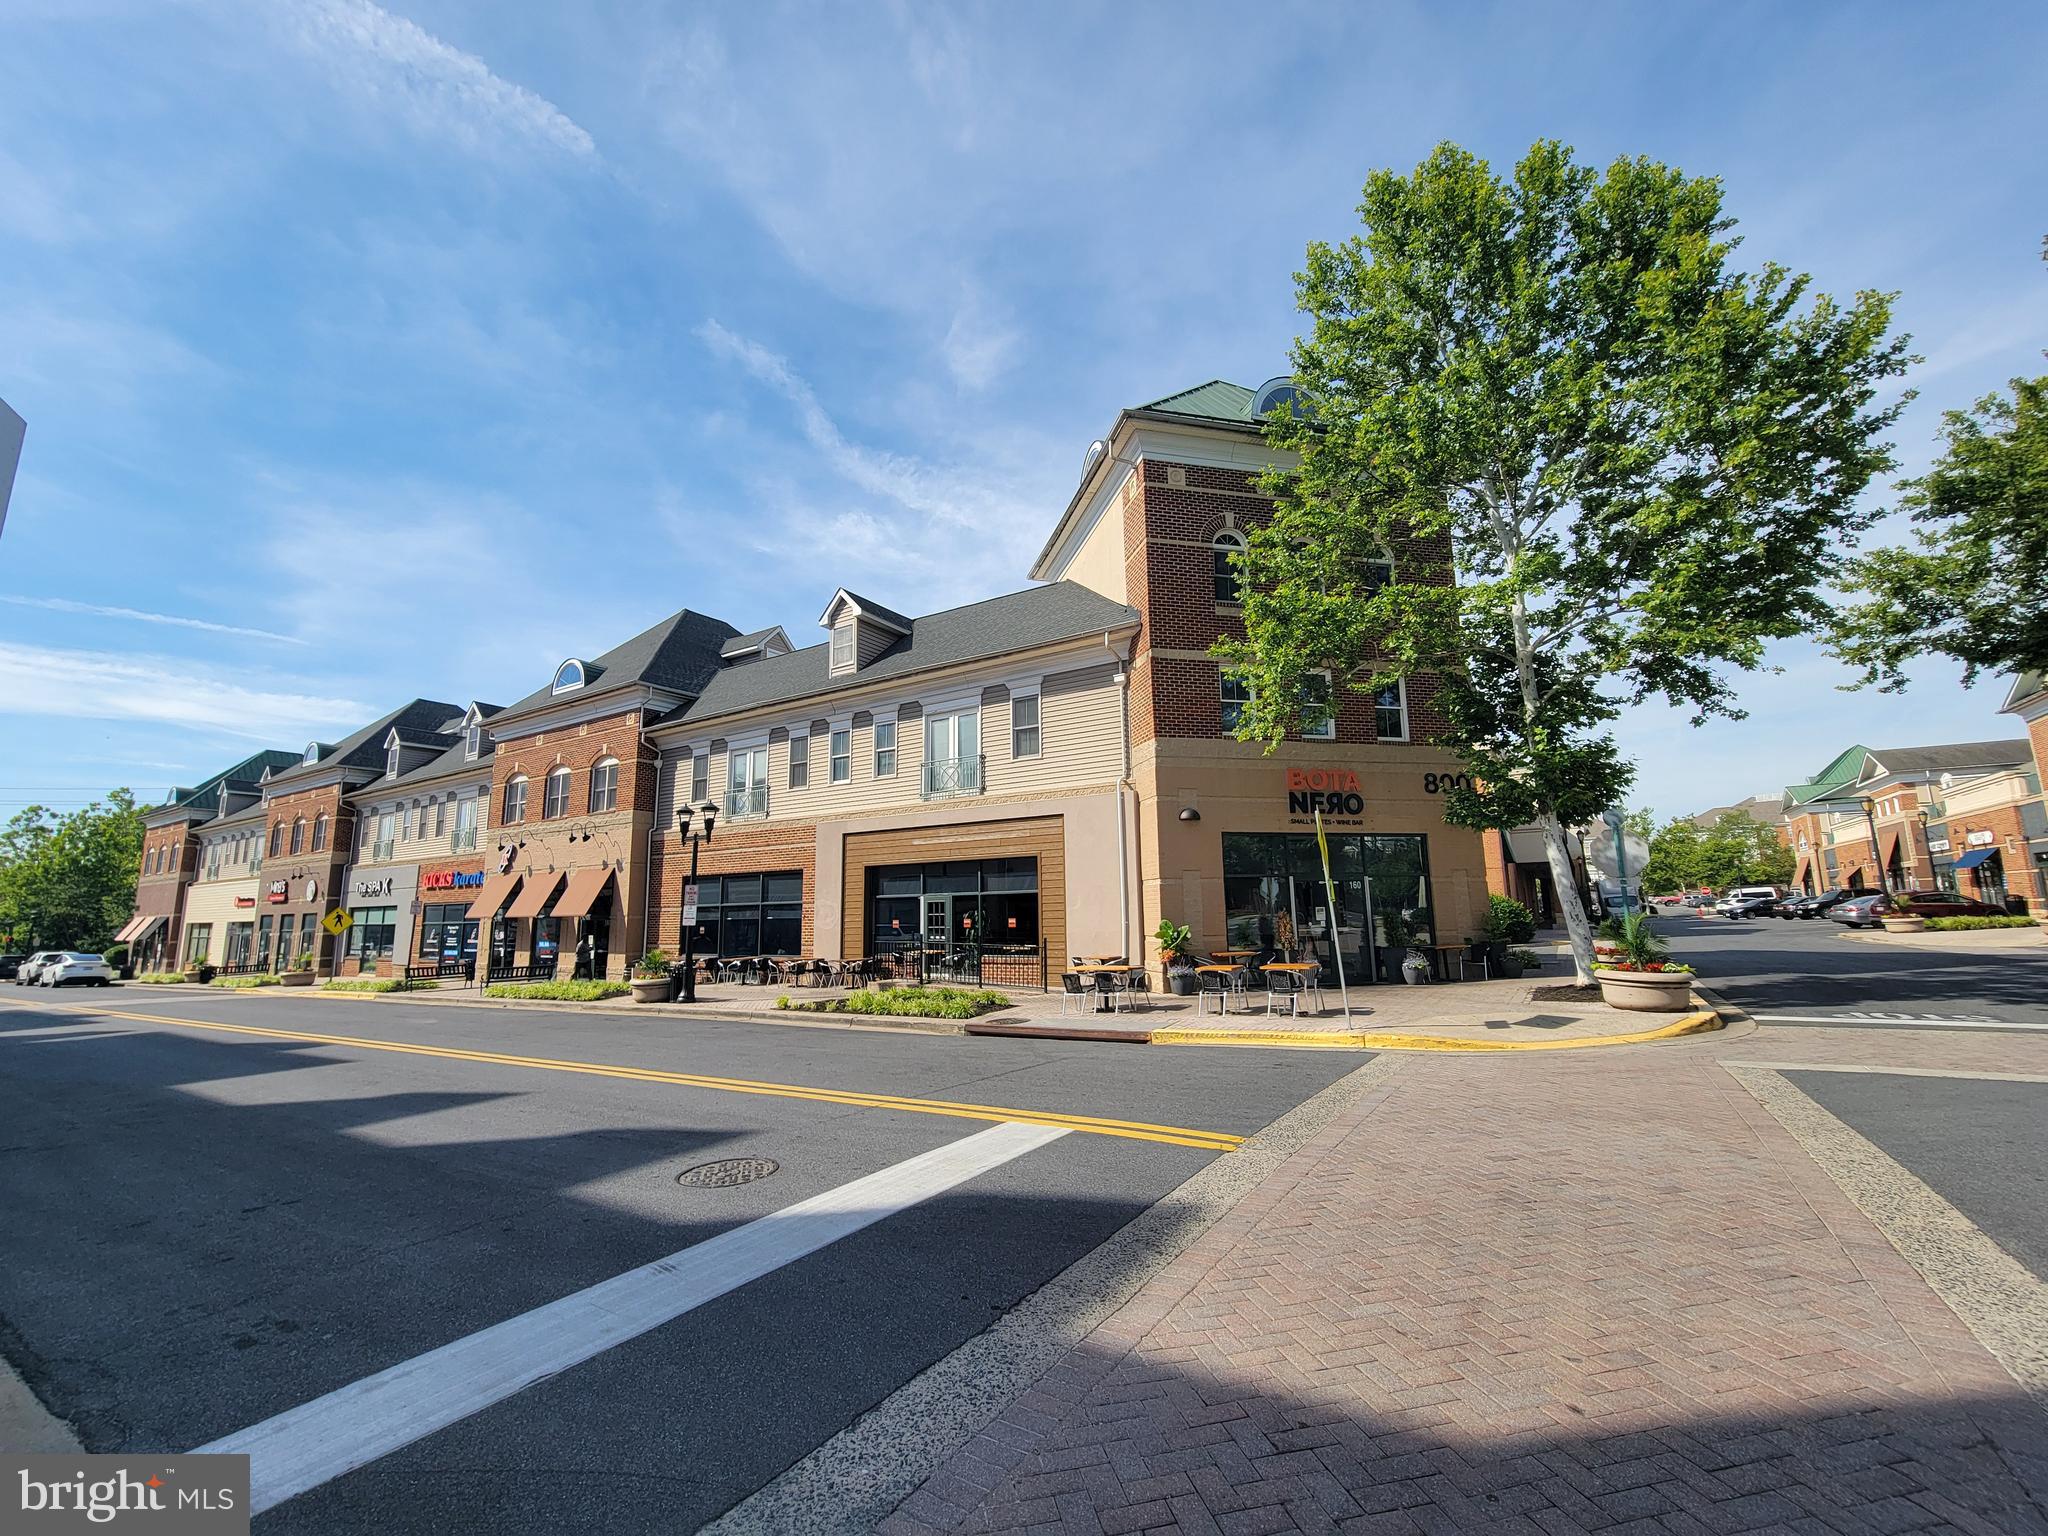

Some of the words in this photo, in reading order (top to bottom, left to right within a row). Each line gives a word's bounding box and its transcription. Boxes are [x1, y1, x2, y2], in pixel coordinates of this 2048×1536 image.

[1287, 768, 1361, 791] BOTA
[1289, 791, 1364, 815] NERO
[422, 871, 453, 887] KICKS
[1349, 881, 1362, 890] 160
